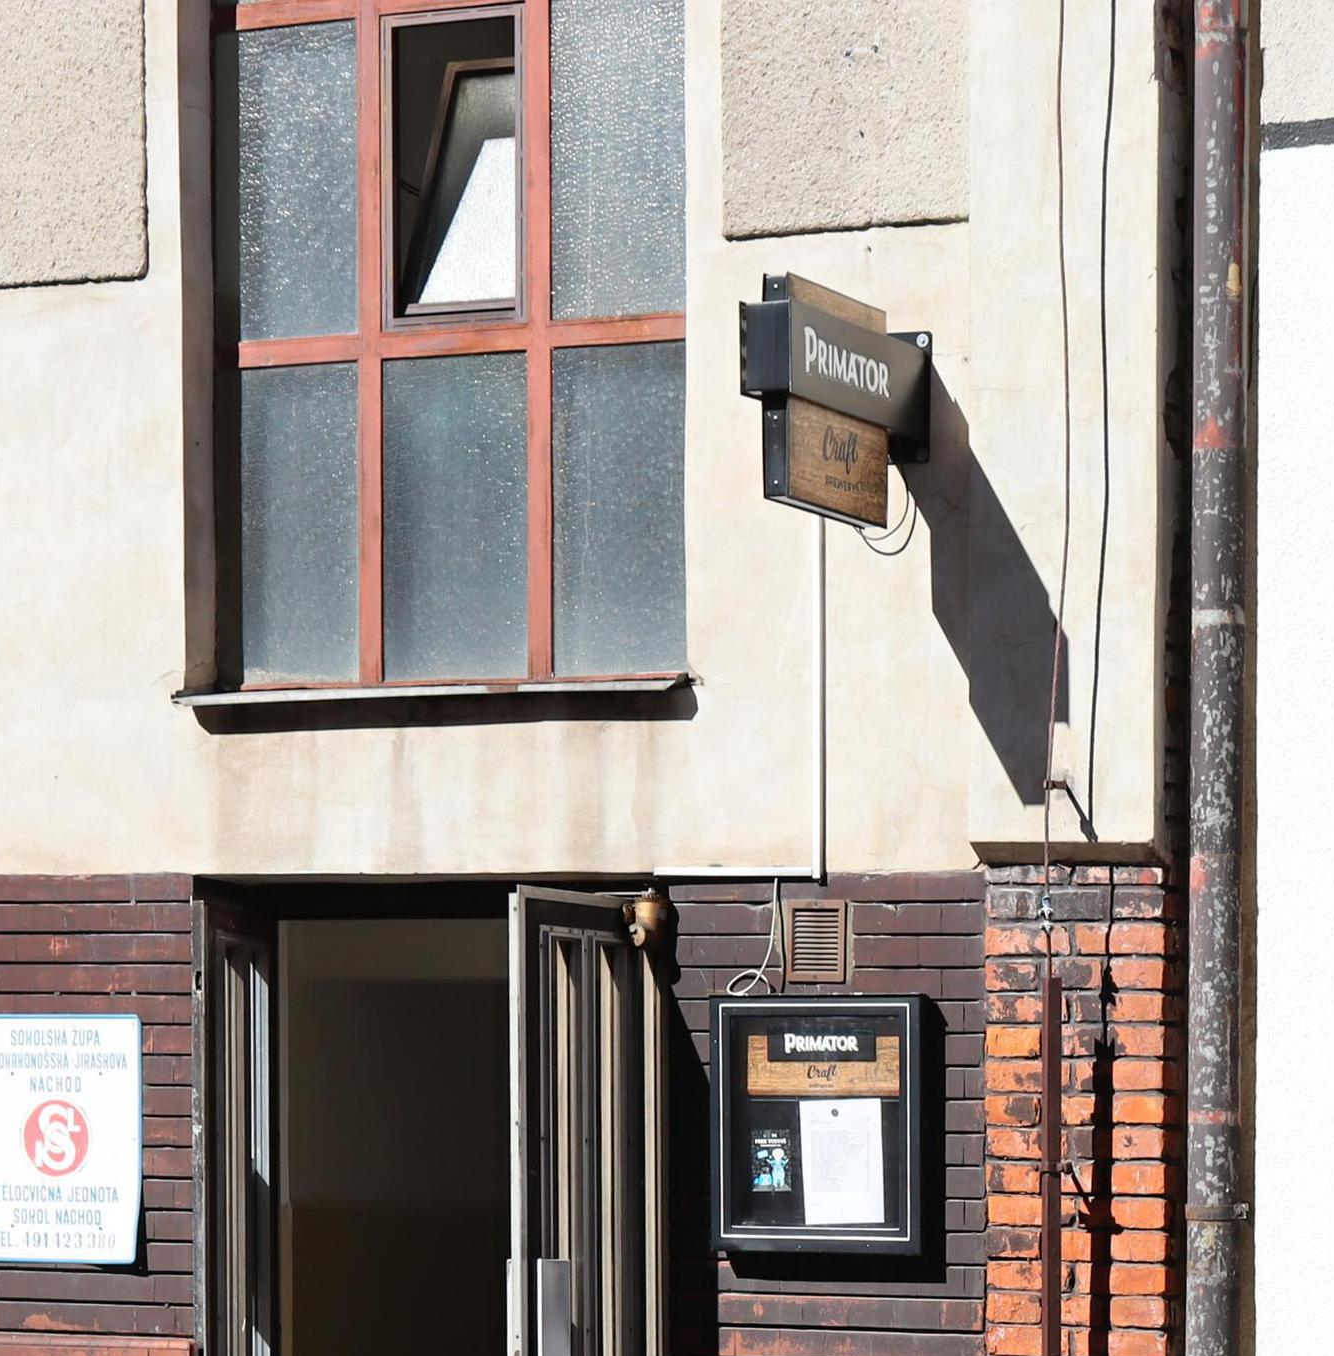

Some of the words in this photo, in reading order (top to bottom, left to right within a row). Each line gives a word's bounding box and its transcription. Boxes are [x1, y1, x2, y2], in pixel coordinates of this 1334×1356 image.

[804, 326, 891, 399] PRIMATOR
[822, 424, 859, 474] Craft
[784, 1033, 860, 1054] PRIMATOR
[807, 1064, 838, 1081] Craft
[67, 1185, 120, 1203] JEDNOTA
[13, 1207, 50, 1224] SOKOL
